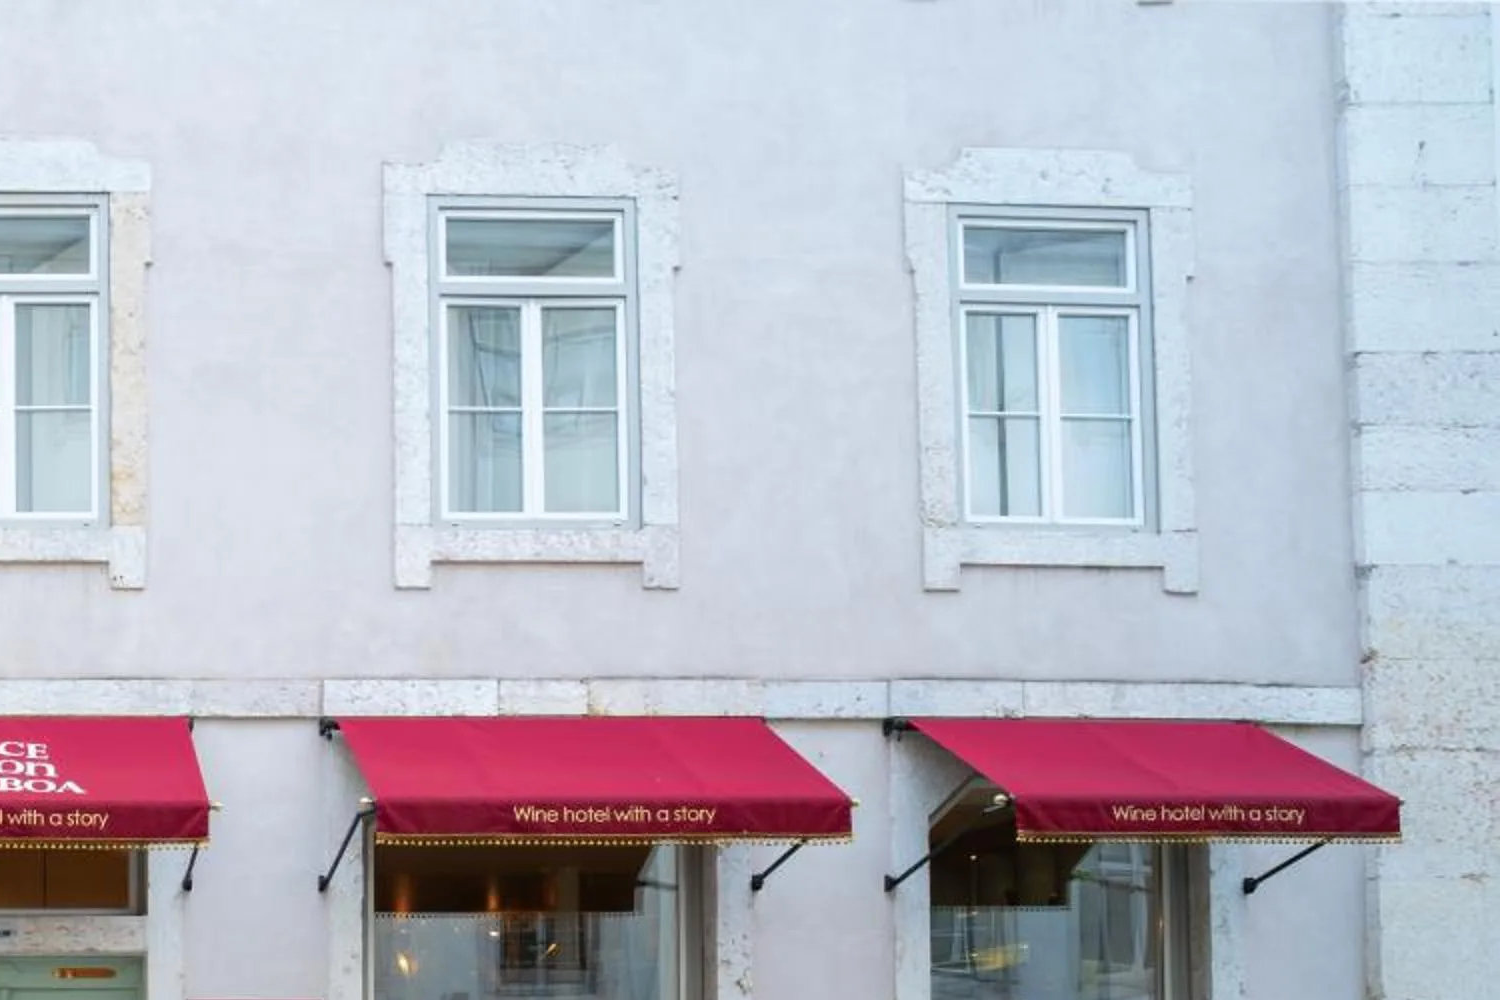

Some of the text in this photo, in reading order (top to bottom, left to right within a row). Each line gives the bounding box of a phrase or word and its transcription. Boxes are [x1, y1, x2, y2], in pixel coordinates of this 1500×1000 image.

[6, 808, 45, 826] with
[49, 813, 63, 826] a
[66, 810, 109, 830] story
[513, 805, 716, 825] Wine hotel with a story
[1112, 805, 1305, 825] Wine hotel with a story
